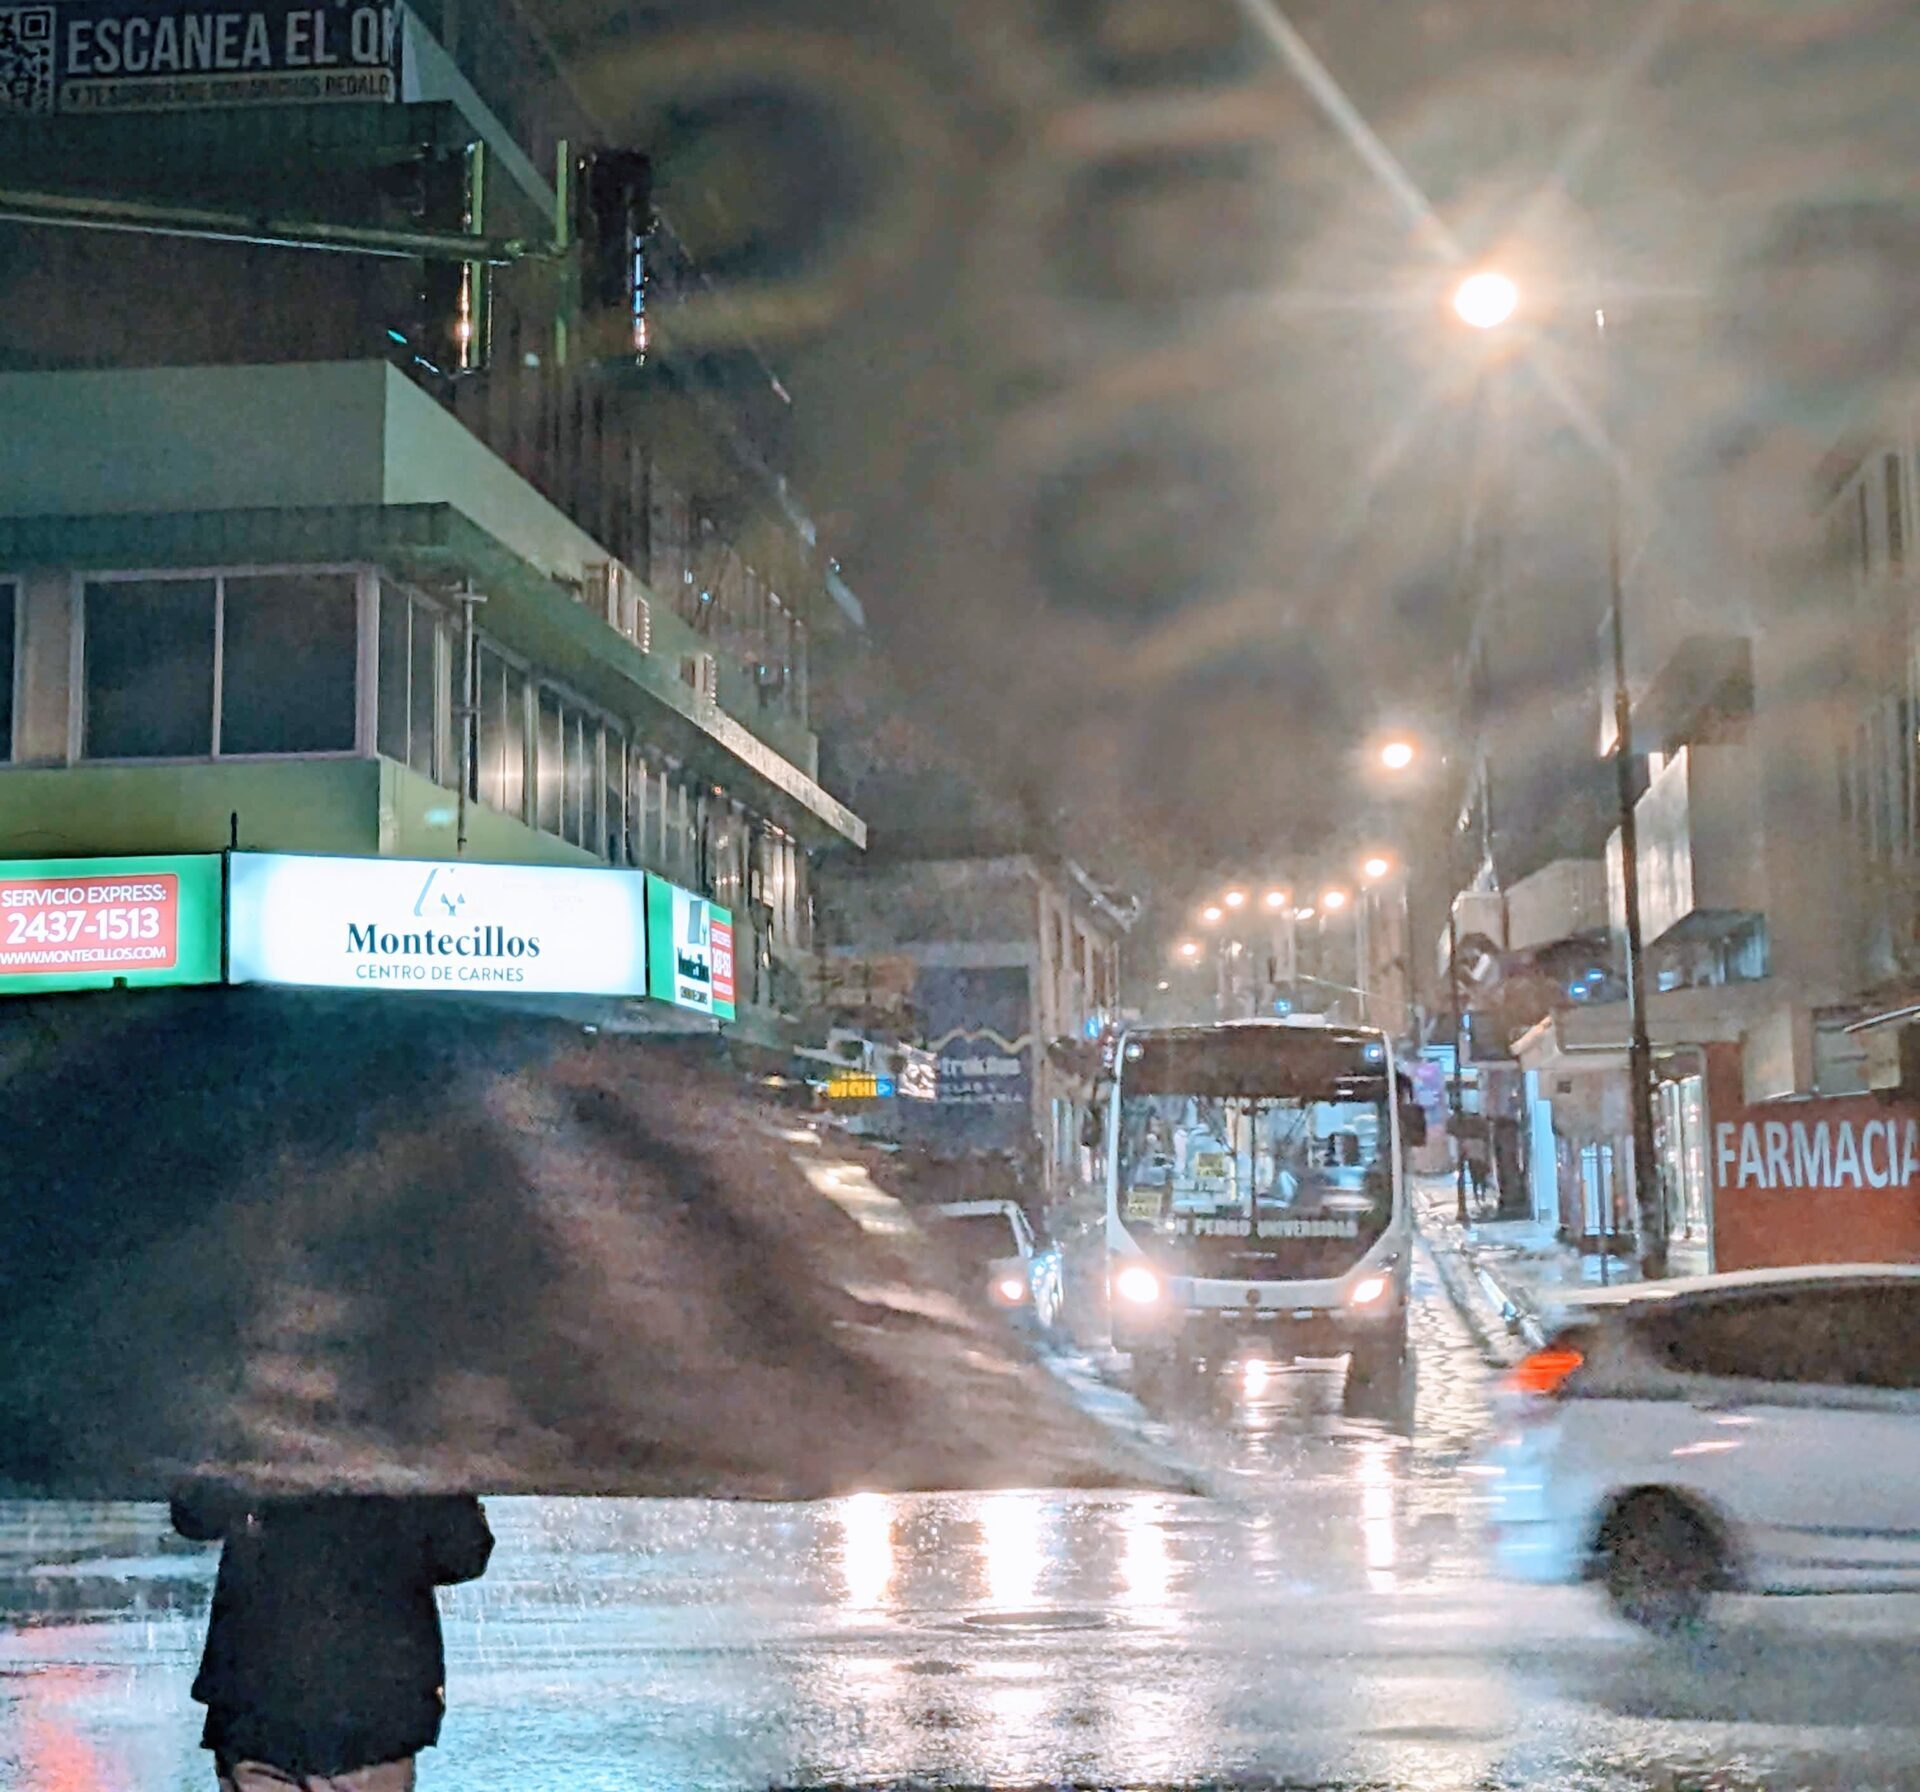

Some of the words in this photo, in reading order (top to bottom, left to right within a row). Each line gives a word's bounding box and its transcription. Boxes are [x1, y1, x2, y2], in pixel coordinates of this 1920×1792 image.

[67, 11, 272, 75] ESCANEA
[285, 8, 338, 66] EL
[1, 887, 84, 908] SERVICIO
[88, 883, 167, 904] EXPRESS:
[6, 906, 160, 944] 2437-1513
[346, 922, 541, 958] Montecillos
[0, 946, 167, 965] WWW.MONTECILLOS.COM
[356, 964, 426, 981] CENTRO
[430, 966, 453, 981] DE
[458, 967, 524, 983] CARNES
[1714, 1118, 1920, 1190] FARMACIA
